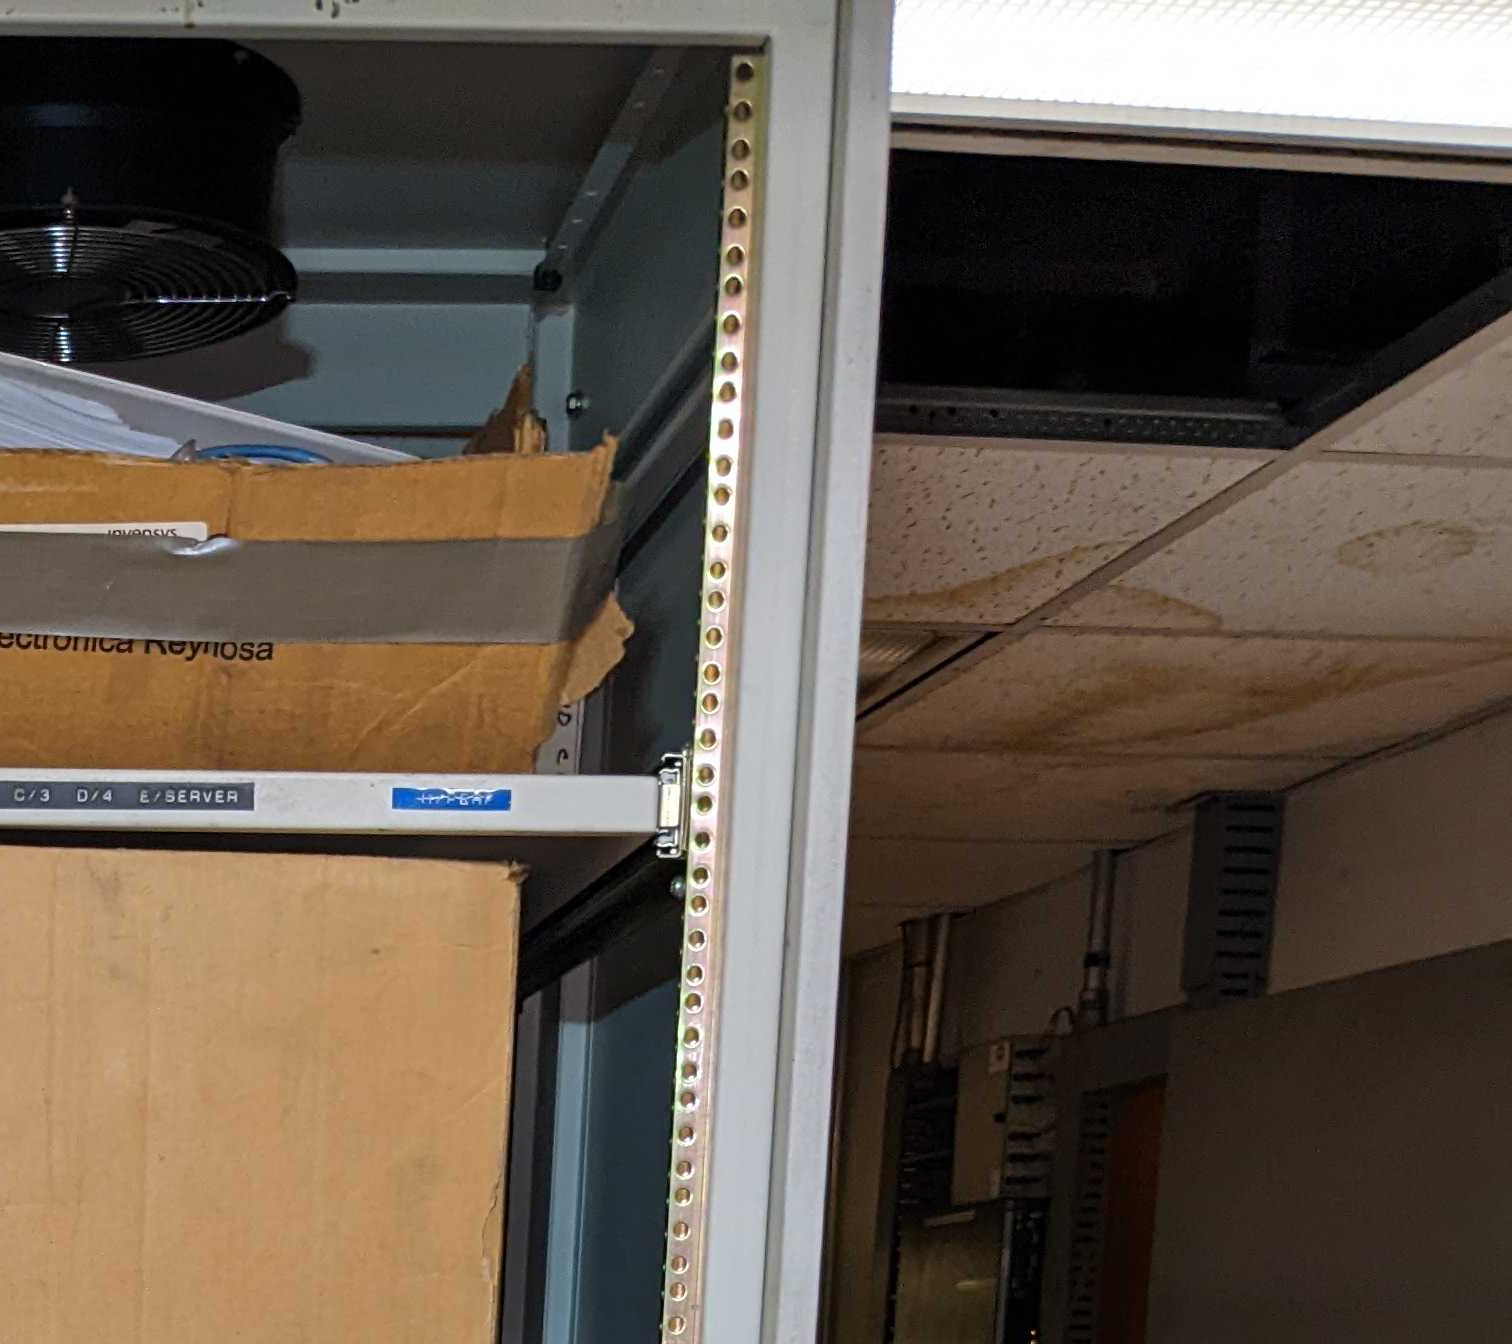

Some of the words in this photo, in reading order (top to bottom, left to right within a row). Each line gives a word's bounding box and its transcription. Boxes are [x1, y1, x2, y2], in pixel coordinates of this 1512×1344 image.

[13, 788, 50, 802] C/3
[77, 789, 113, 802] D/4
[139, 789, 239, 803] E/SERVER
